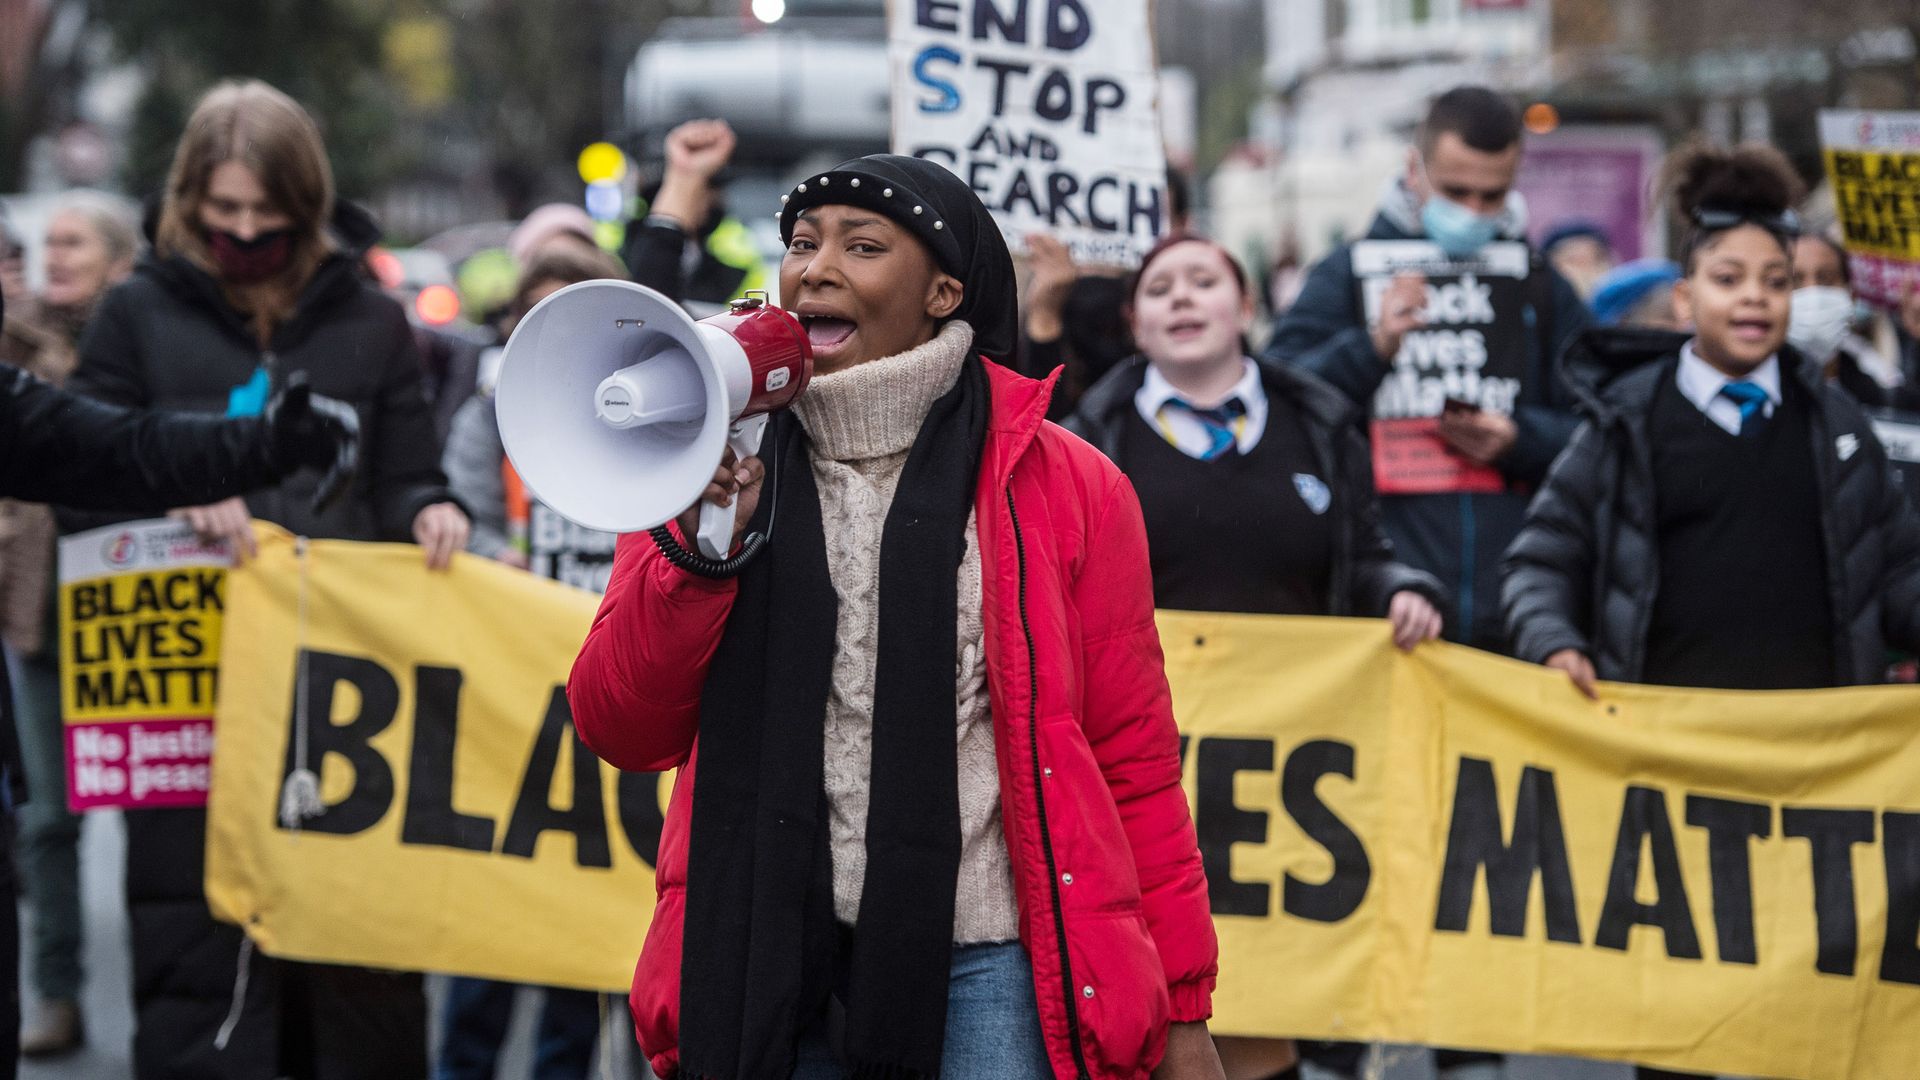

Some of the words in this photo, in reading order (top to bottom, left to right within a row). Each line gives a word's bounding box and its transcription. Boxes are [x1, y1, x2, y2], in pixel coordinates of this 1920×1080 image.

[915, 0, 1092, 51] END
[912, 45, 1126, 133] STOP
[967, 125, 1058, 161] AND
[1835, 154, 1920, 178] BLAC
[71, 571, 224, 621] BLACK
[73, 619, 203, 664] LIVES
[75, 667, 217, 709] MATT
[72, 726, 124, 760] No
[128, 723, 214, 764] justi
[75, 763, 126, 796] No
[131, 763, 210, 800] peac
[274, 648, 664, 870] BLA
[1180, 736, 1370, 923] ES
[1434, 756, 1920, 985] MATT
